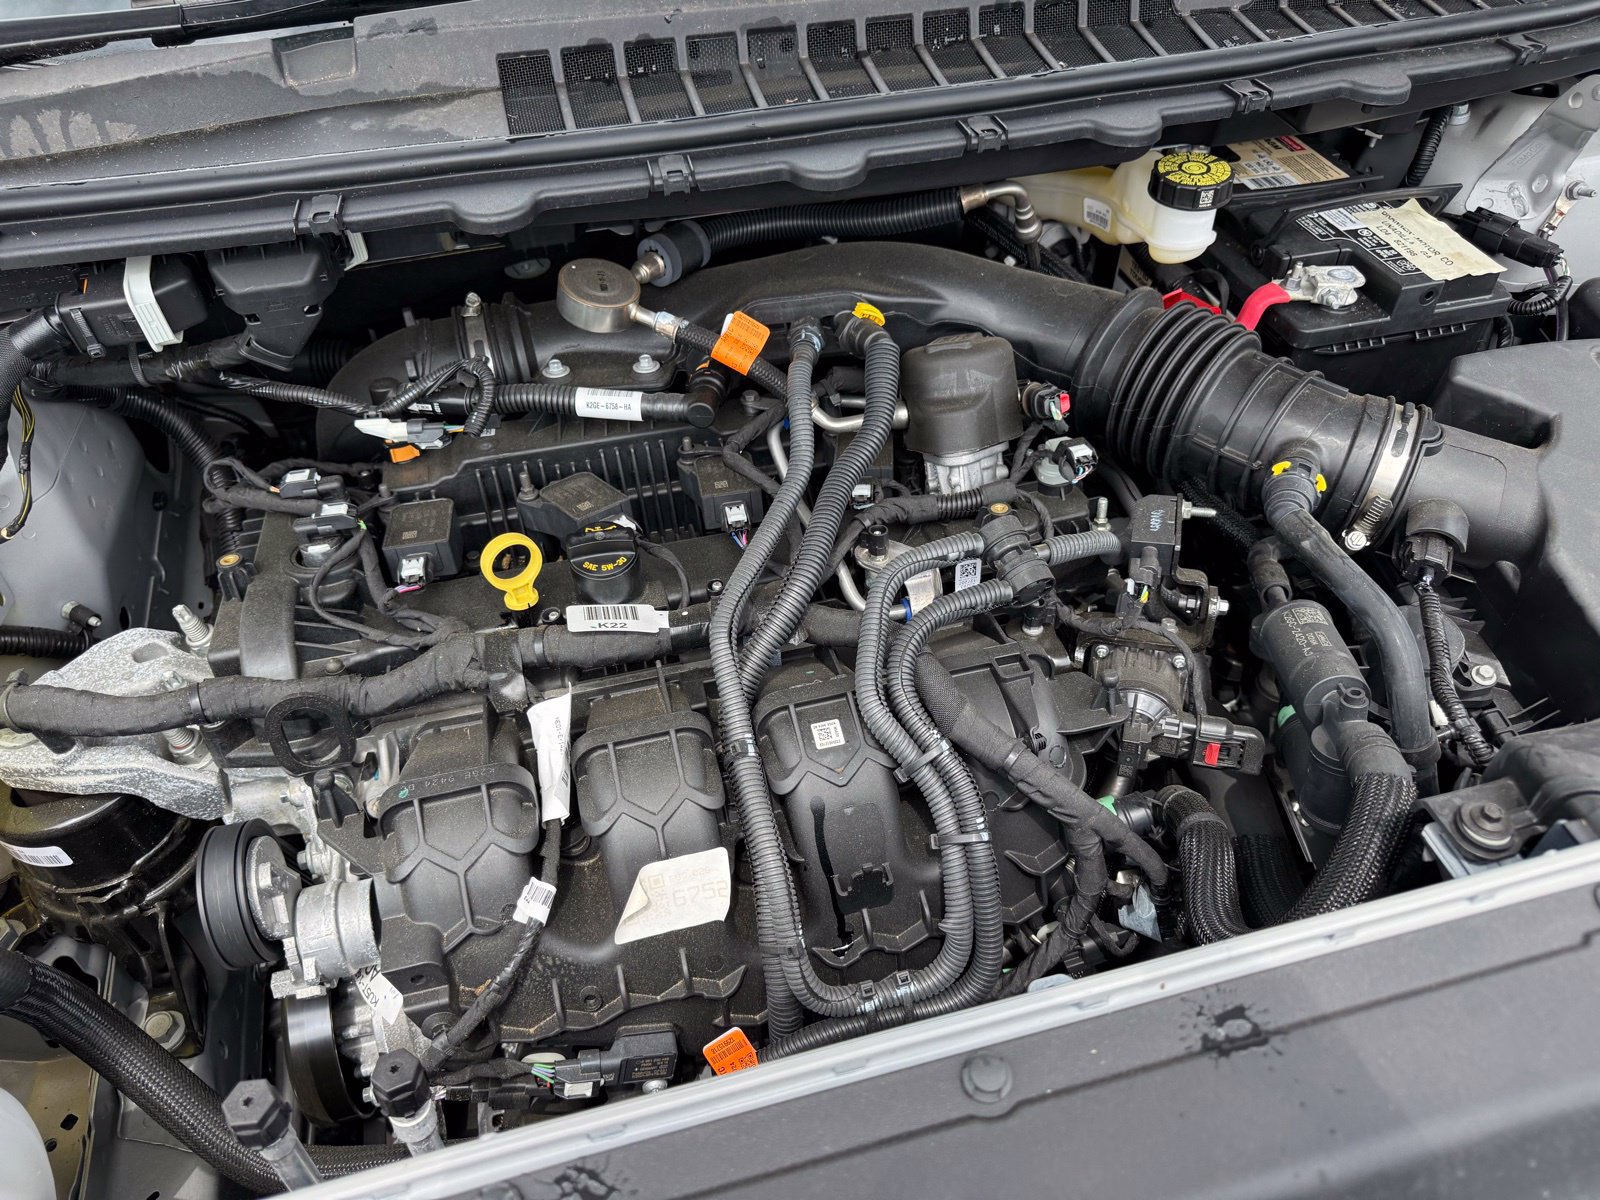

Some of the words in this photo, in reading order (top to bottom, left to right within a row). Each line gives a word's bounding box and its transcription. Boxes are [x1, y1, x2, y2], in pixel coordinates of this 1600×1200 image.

[1440, 257, 1454, 266] CO
[582, 561, 599, 571] SAE
[601, 556, 627, 572] 5W-30
[672, 880, 729, 906] 6752
